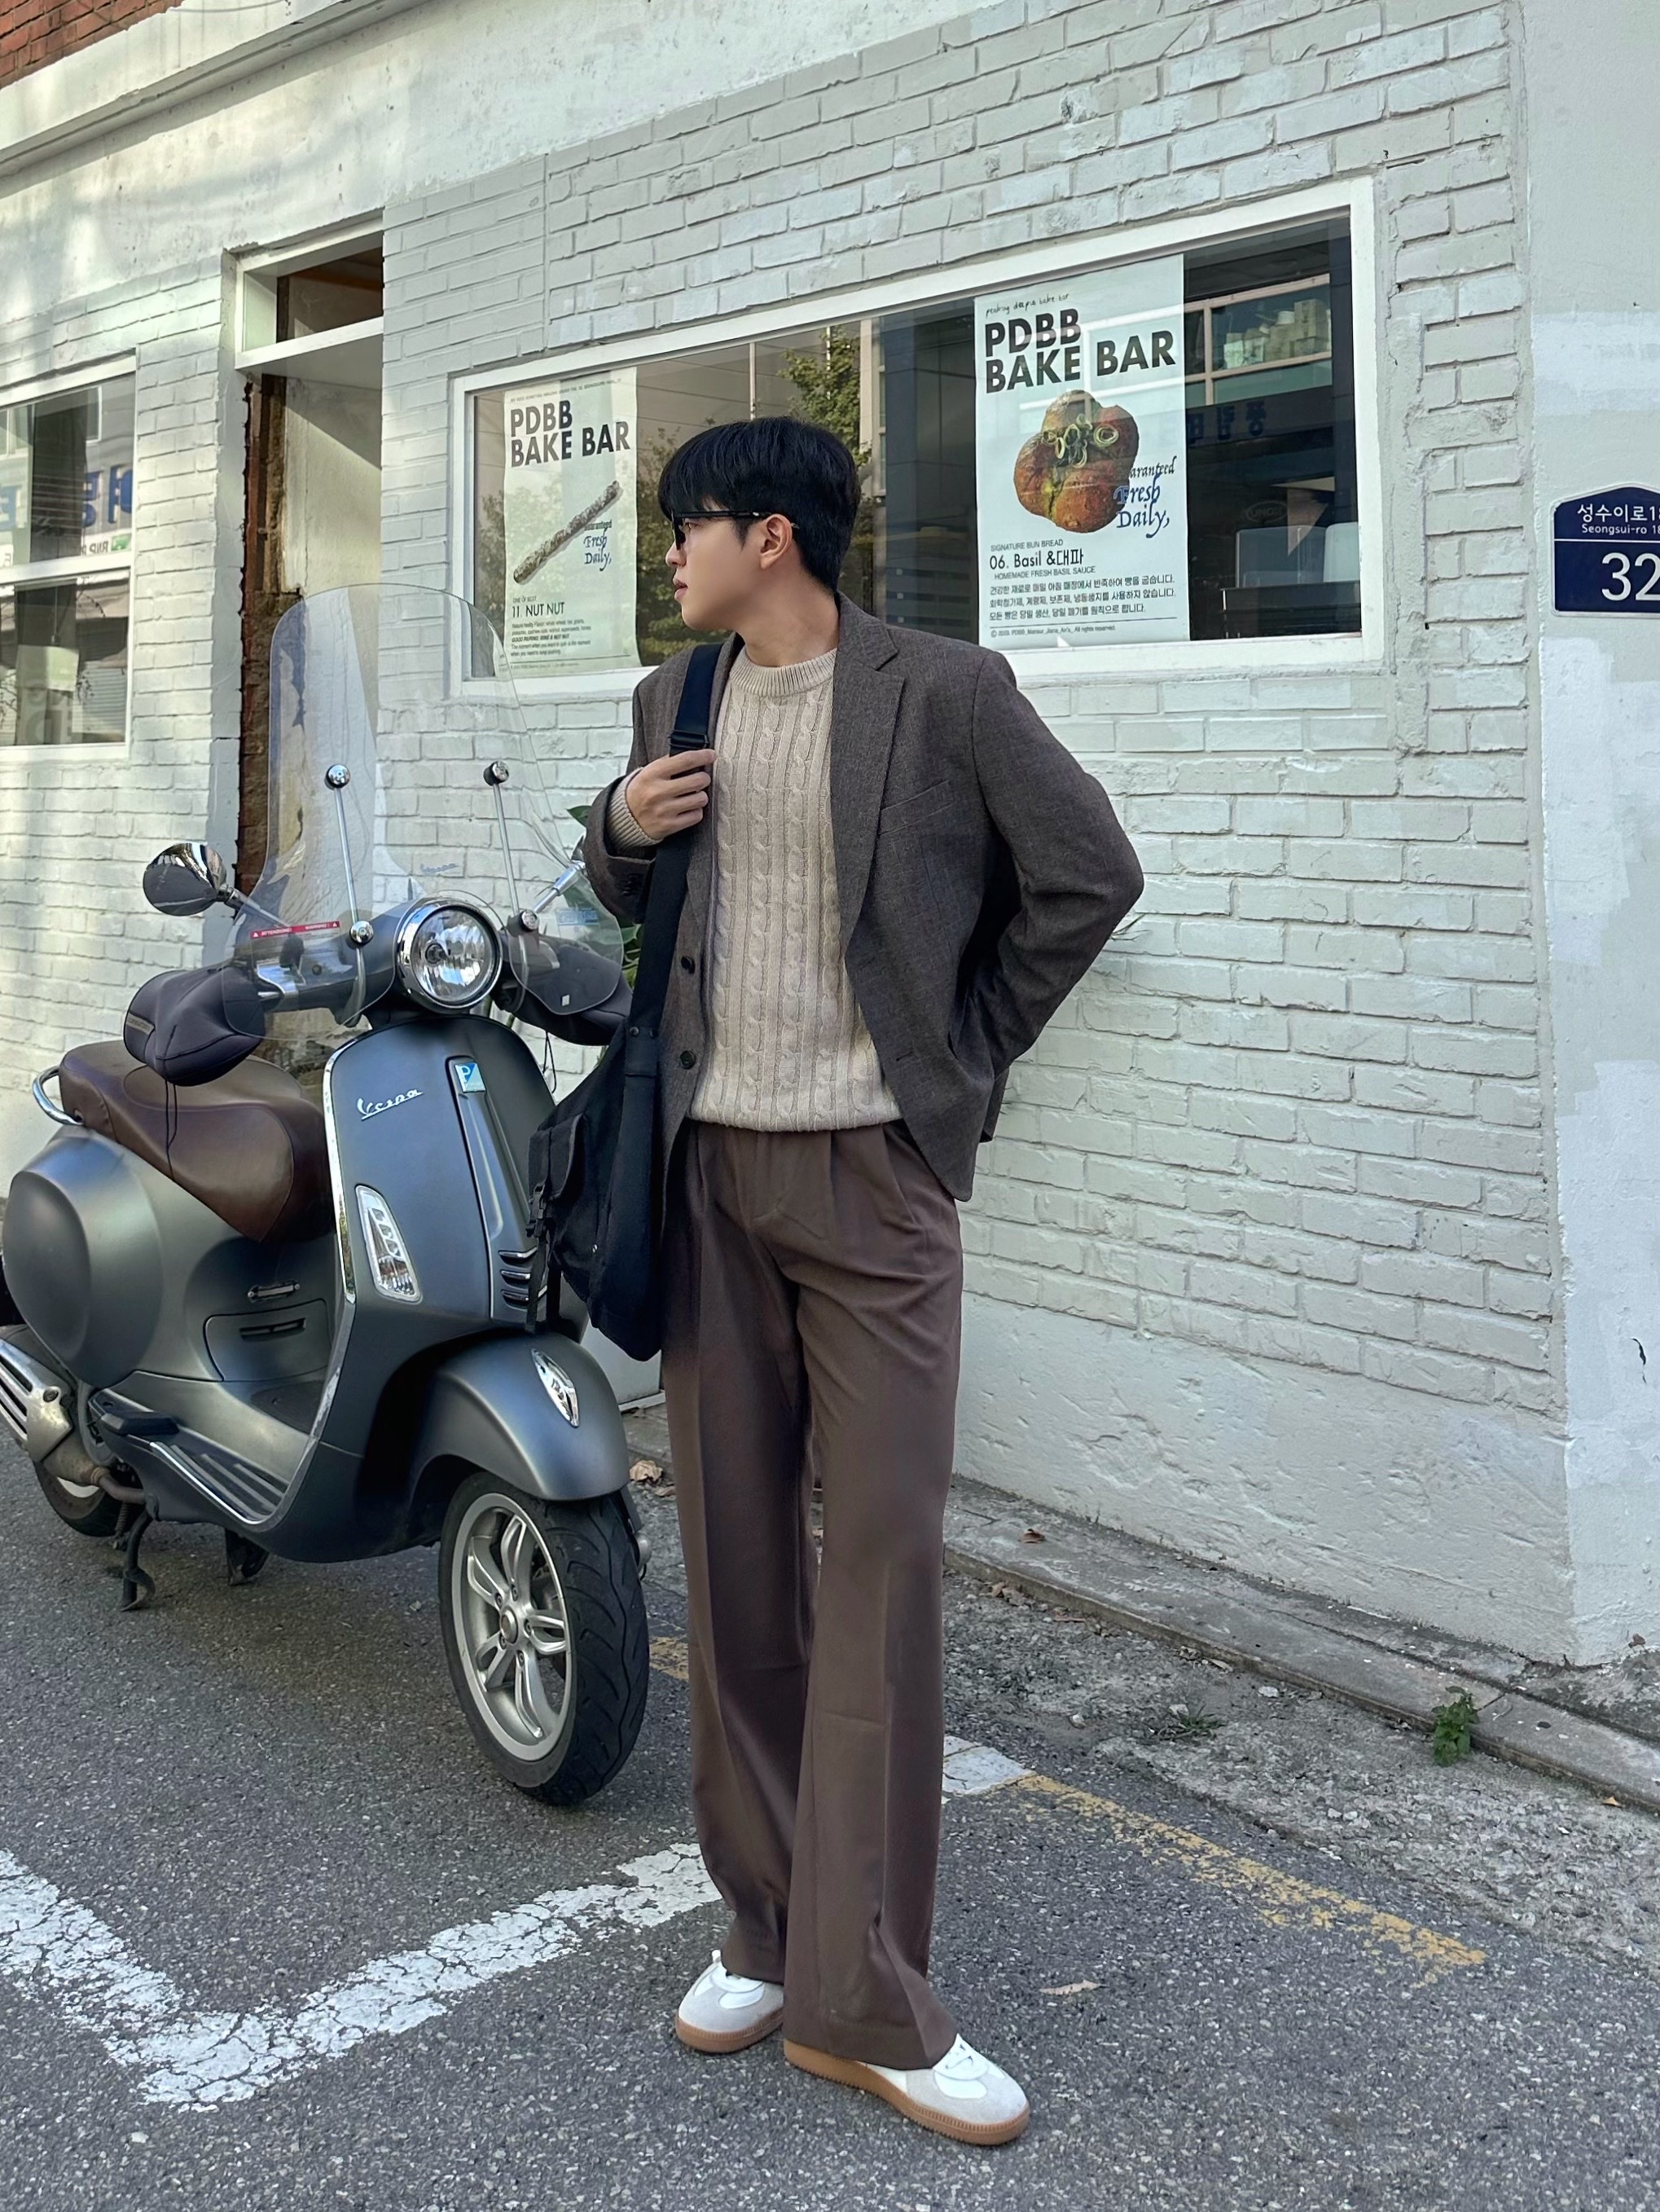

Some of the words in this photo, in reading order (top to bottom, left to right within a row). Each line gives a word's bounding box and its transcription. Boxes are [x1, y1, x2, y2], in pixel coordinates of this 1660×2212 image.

[985, 308, 1081, 358] PDBB
[986, 345, 1081, 394] BAKE
[1096, 330, 1175, 376] BAR
[510, 399, 573, 438] PDBB
[511, 431, 573, 468] BAKE
[582, 420, 630, 457] BAR
[1129, 455, 1178, 478] aranteed
[1113, 473, 1161, 504] Fresh
[1116, 499, 1170, 539] Daily,
[1577, 503, 1660, 523] 성수이로1
[583, 526, 608, 548] Fresh
[1582, 523, 1647, 535] Seongsui-ro
[990, 542, 1025, 552] SIGNATURE
[1026, 541, 1040, 549] BUN
[1042, 539, 1064, 548] BREAD
[584, 545, 612, 572] Daily,
[990, 554, 1009, 569] 06.
[1014, 550, 1042, 568] Basil
[994, 570, 1030, 580] HOMEMADE
[1031, 569, 1052, 577] FRESH
[1053, 568, 1071, 576] BASIL
[1072, 565, 1096, 574] SAUCE
[1601, 552, 1660, 601] 32
[1048, 582, 1062, 591] 아침
[1111, 589, 1140, 600] 사용하지
[525, 604, 544, 618] NUT
[547, 601, 565, 615] NUT
[356, 1088, 424, 1121] Vespa
